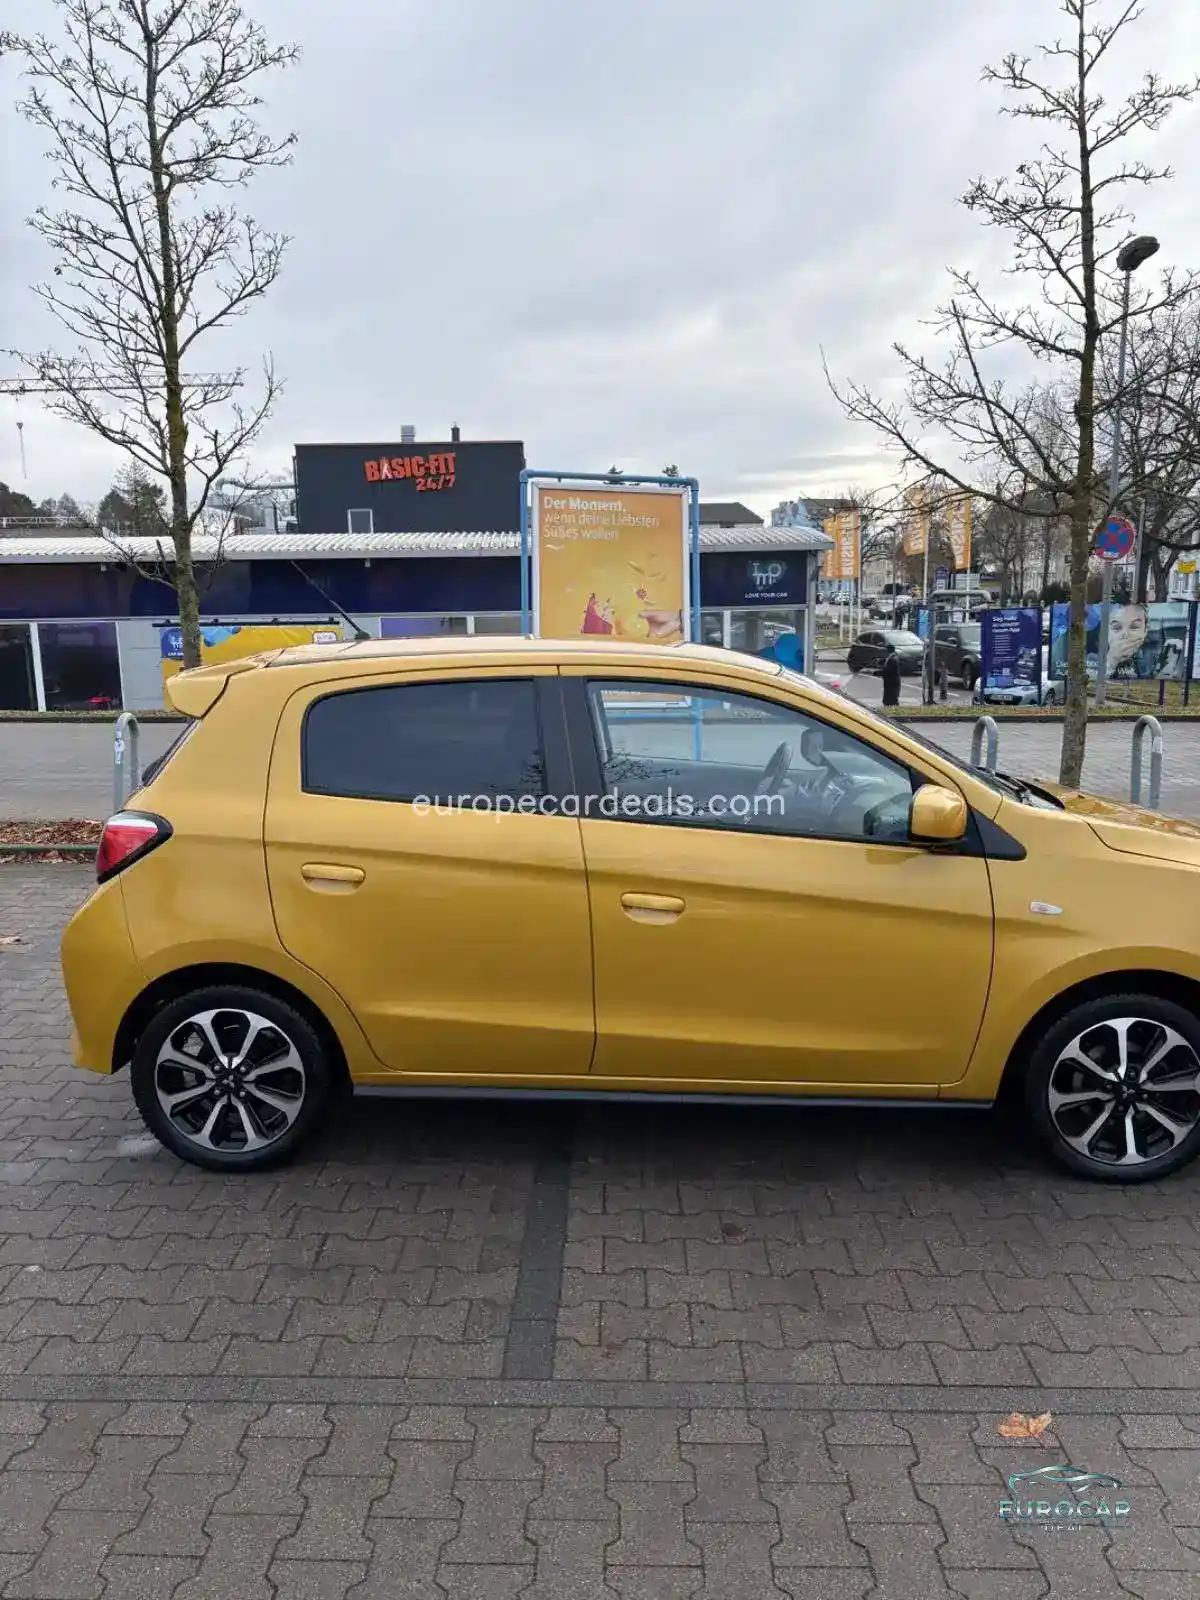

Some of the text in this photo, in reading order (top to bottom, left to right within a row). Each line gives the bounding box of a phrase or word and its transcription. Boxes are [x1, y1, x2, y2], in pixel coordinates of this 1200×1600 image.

[416, 475, 456, 492] 24/7
[543, 496, 626, 512] Der Moment,
[544, 512, 576, 523] wenn
[612, 514, 660, 527] Liebsten
